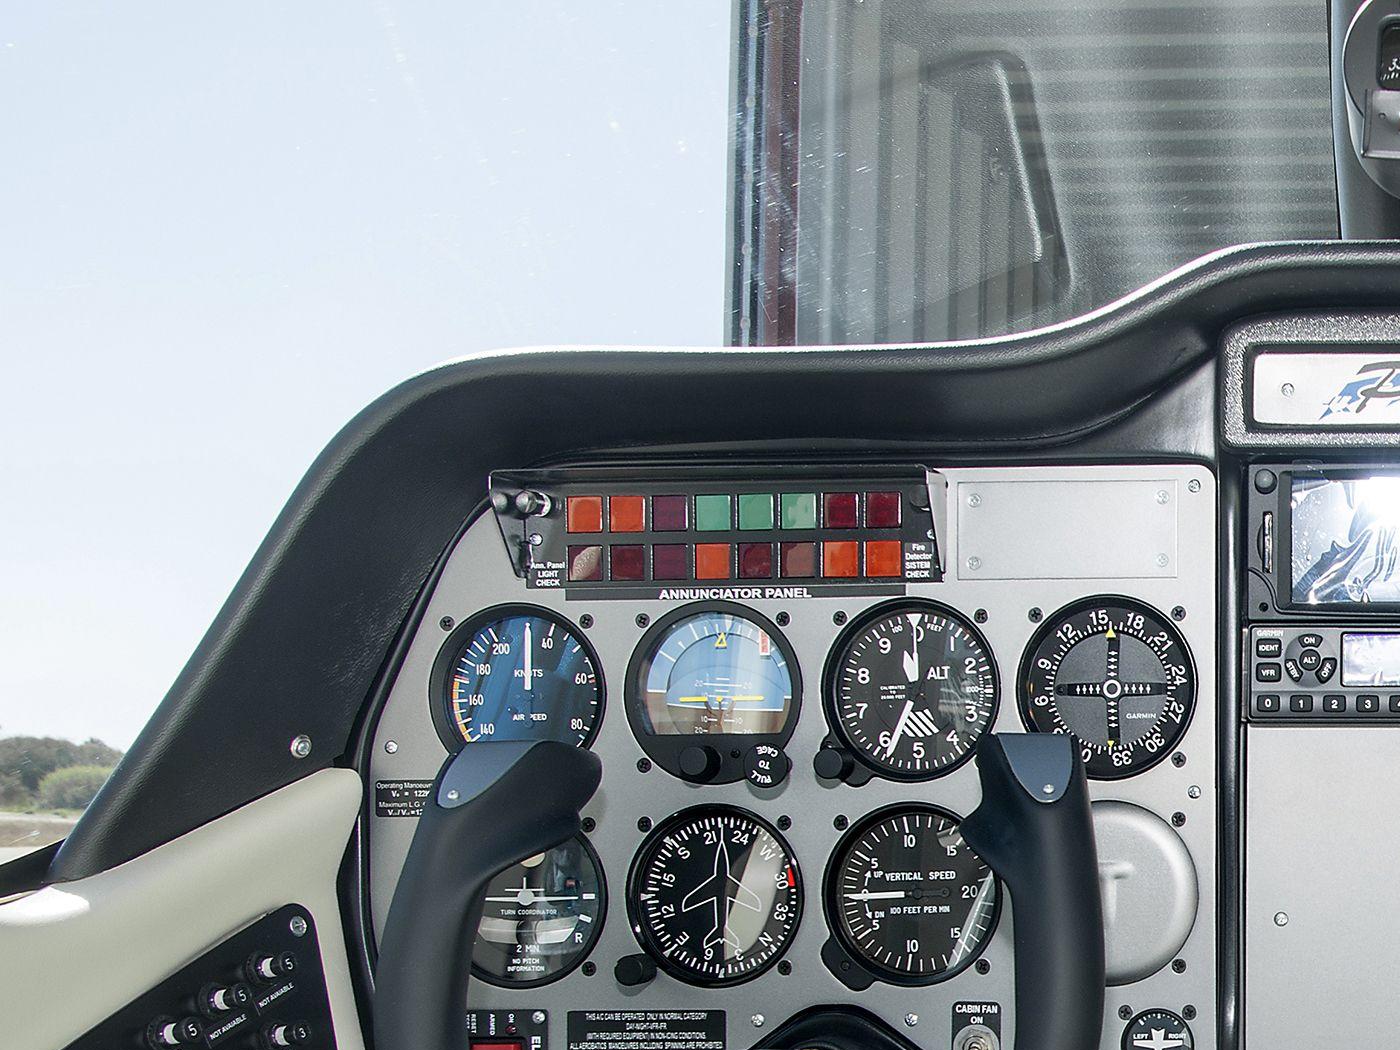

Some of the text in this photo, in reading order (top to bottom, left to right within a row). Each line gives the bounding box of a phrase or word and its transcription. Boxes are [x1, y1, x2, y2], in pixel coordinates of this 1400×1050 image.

[912, 543, 926, 551] Fire
[905, 552, 932, 560] Detector
[537, 570, 558, 578] LIGHT
[905, 570, 930, 578] CHECK
[659, 587, 812, 600] ANNUNCIATOR PANEL
[1089, 610, 1109, 625] 15
[1126, 612, 1145, 630] 18
[927, 623, 943, 632] FEET
[1055, 623, 1076, 643] 12
[541, 638, 553, 649] 40
[878, 637, 891, 654] 9
[1154, 632, 1174, 651] 21
[1304, 636, 1315, 644] ON
[492, 644, 510, 655] 200
[1258, 644, 1279, 652] IDENT
[964, 658, 977, 674] 2
[1303, 656, 1316, 664] ALT
[476, 664, 490, 675] 180
[857, 668, 870, 684] 8
[927, 666, 950, 680] ALT
[1171, 665, 1188, 686] 24
[1285, 661, 1299, 679] STBY
[1321, 662, 1333, 678] OFF
[575, 673, 587, 684] 60
[469, 694, 484, 705] 160
[1264, 700, 1271, 708] 0
[1331, 700, 1338, 708] 2
[1365, 700, 1371, 708] 3
[856, 703, 868, 719] 7
[965, 705, 978, 722] 3
[480, 723, 495, 735] 140
[571, 719, 583, 730] 80
[946, 730, 959, 745] 4
[756, 745, 778, 758] CAGE
[912, 742, 925, 759] 5
[758, 761, 771, 770] TO
[751, 770, 772, 784] PULL
[703, 831, 717, 844] 21
[731, 831, 750, 845] 24
[903, 834, 916, 848] 10
[679, 847, 691, 860] S
[946, 846, 957, 856] 15
[871, 858, 878, 869] 5
[662, 872, 676, 888] 15
[873, 870, 884, 878] UP
[885, 871, 956, 881] VERTICAL SPEED
[961, 885, 978, 898] 20
[662, 904, 675, 918] 12
[575, 932, 583, 943] R
[906, 940, 919, 953] 10
[956, 1005, 998, 1013] CABIN FAN
